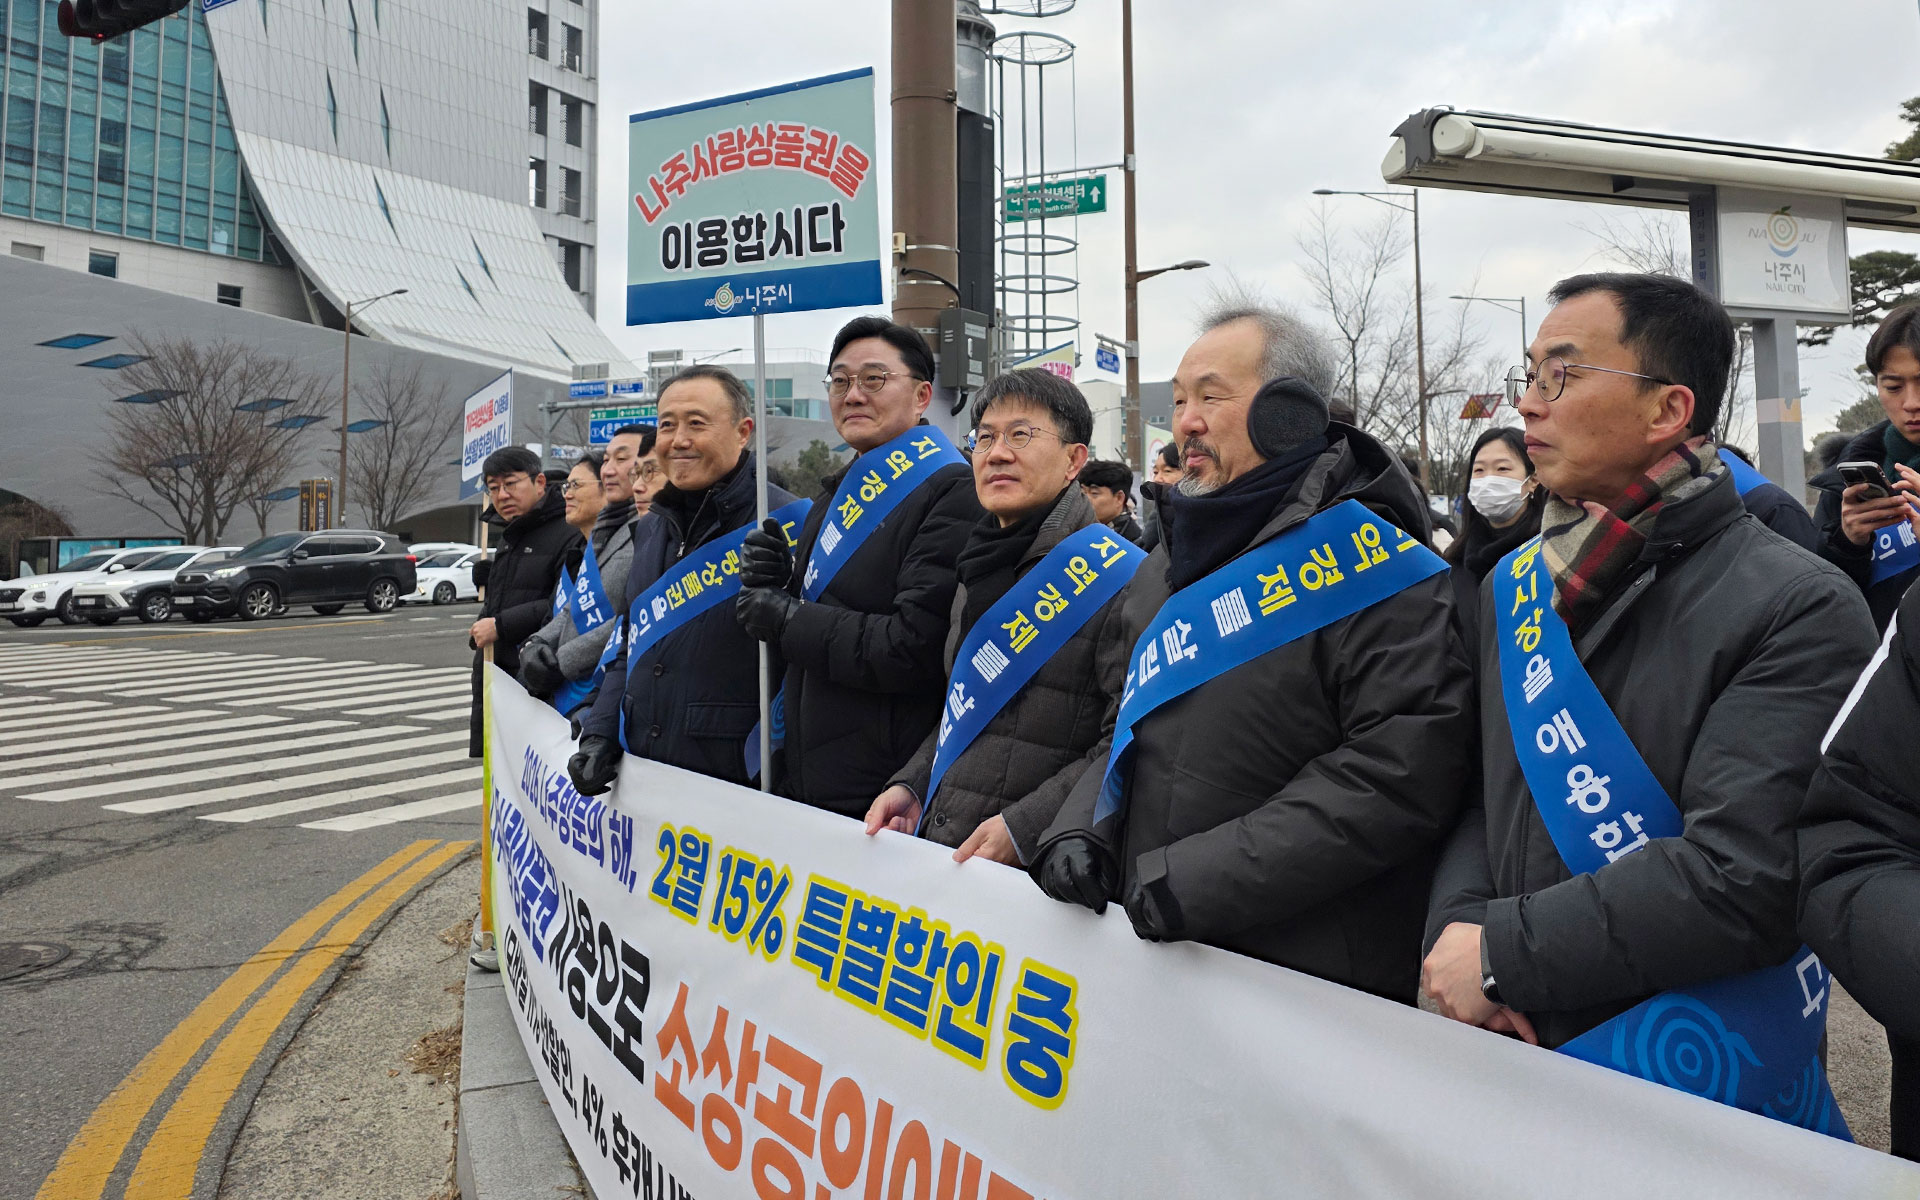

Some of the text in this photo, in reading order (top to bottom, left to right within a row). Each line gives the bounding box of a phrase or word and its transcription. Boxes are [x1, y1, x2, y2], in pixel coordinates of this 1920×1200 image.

[635, 123, 870, 224] 나주사랑상품권을
[662, 202, 846, 270] 이용합시다
[1765, 261, 1806, 283] 나주시
[746, 283, 793, 307] 나주시
[820, 436, 942, 556] 지역경제를
[971, 536, 1128, 684] 지역경제를
[1511, 533, 1555, 704] 통시장을
[548, 881, 651, 1085] 사용으로
[651, 828, 711, 919] 2월
[711, 852, 791, 957] 15%
[793, 881, 1000, 1061] 특별할인
[1006, 969, 1072, 1100] 중
[582, 1073, 608, 1158] 4%
